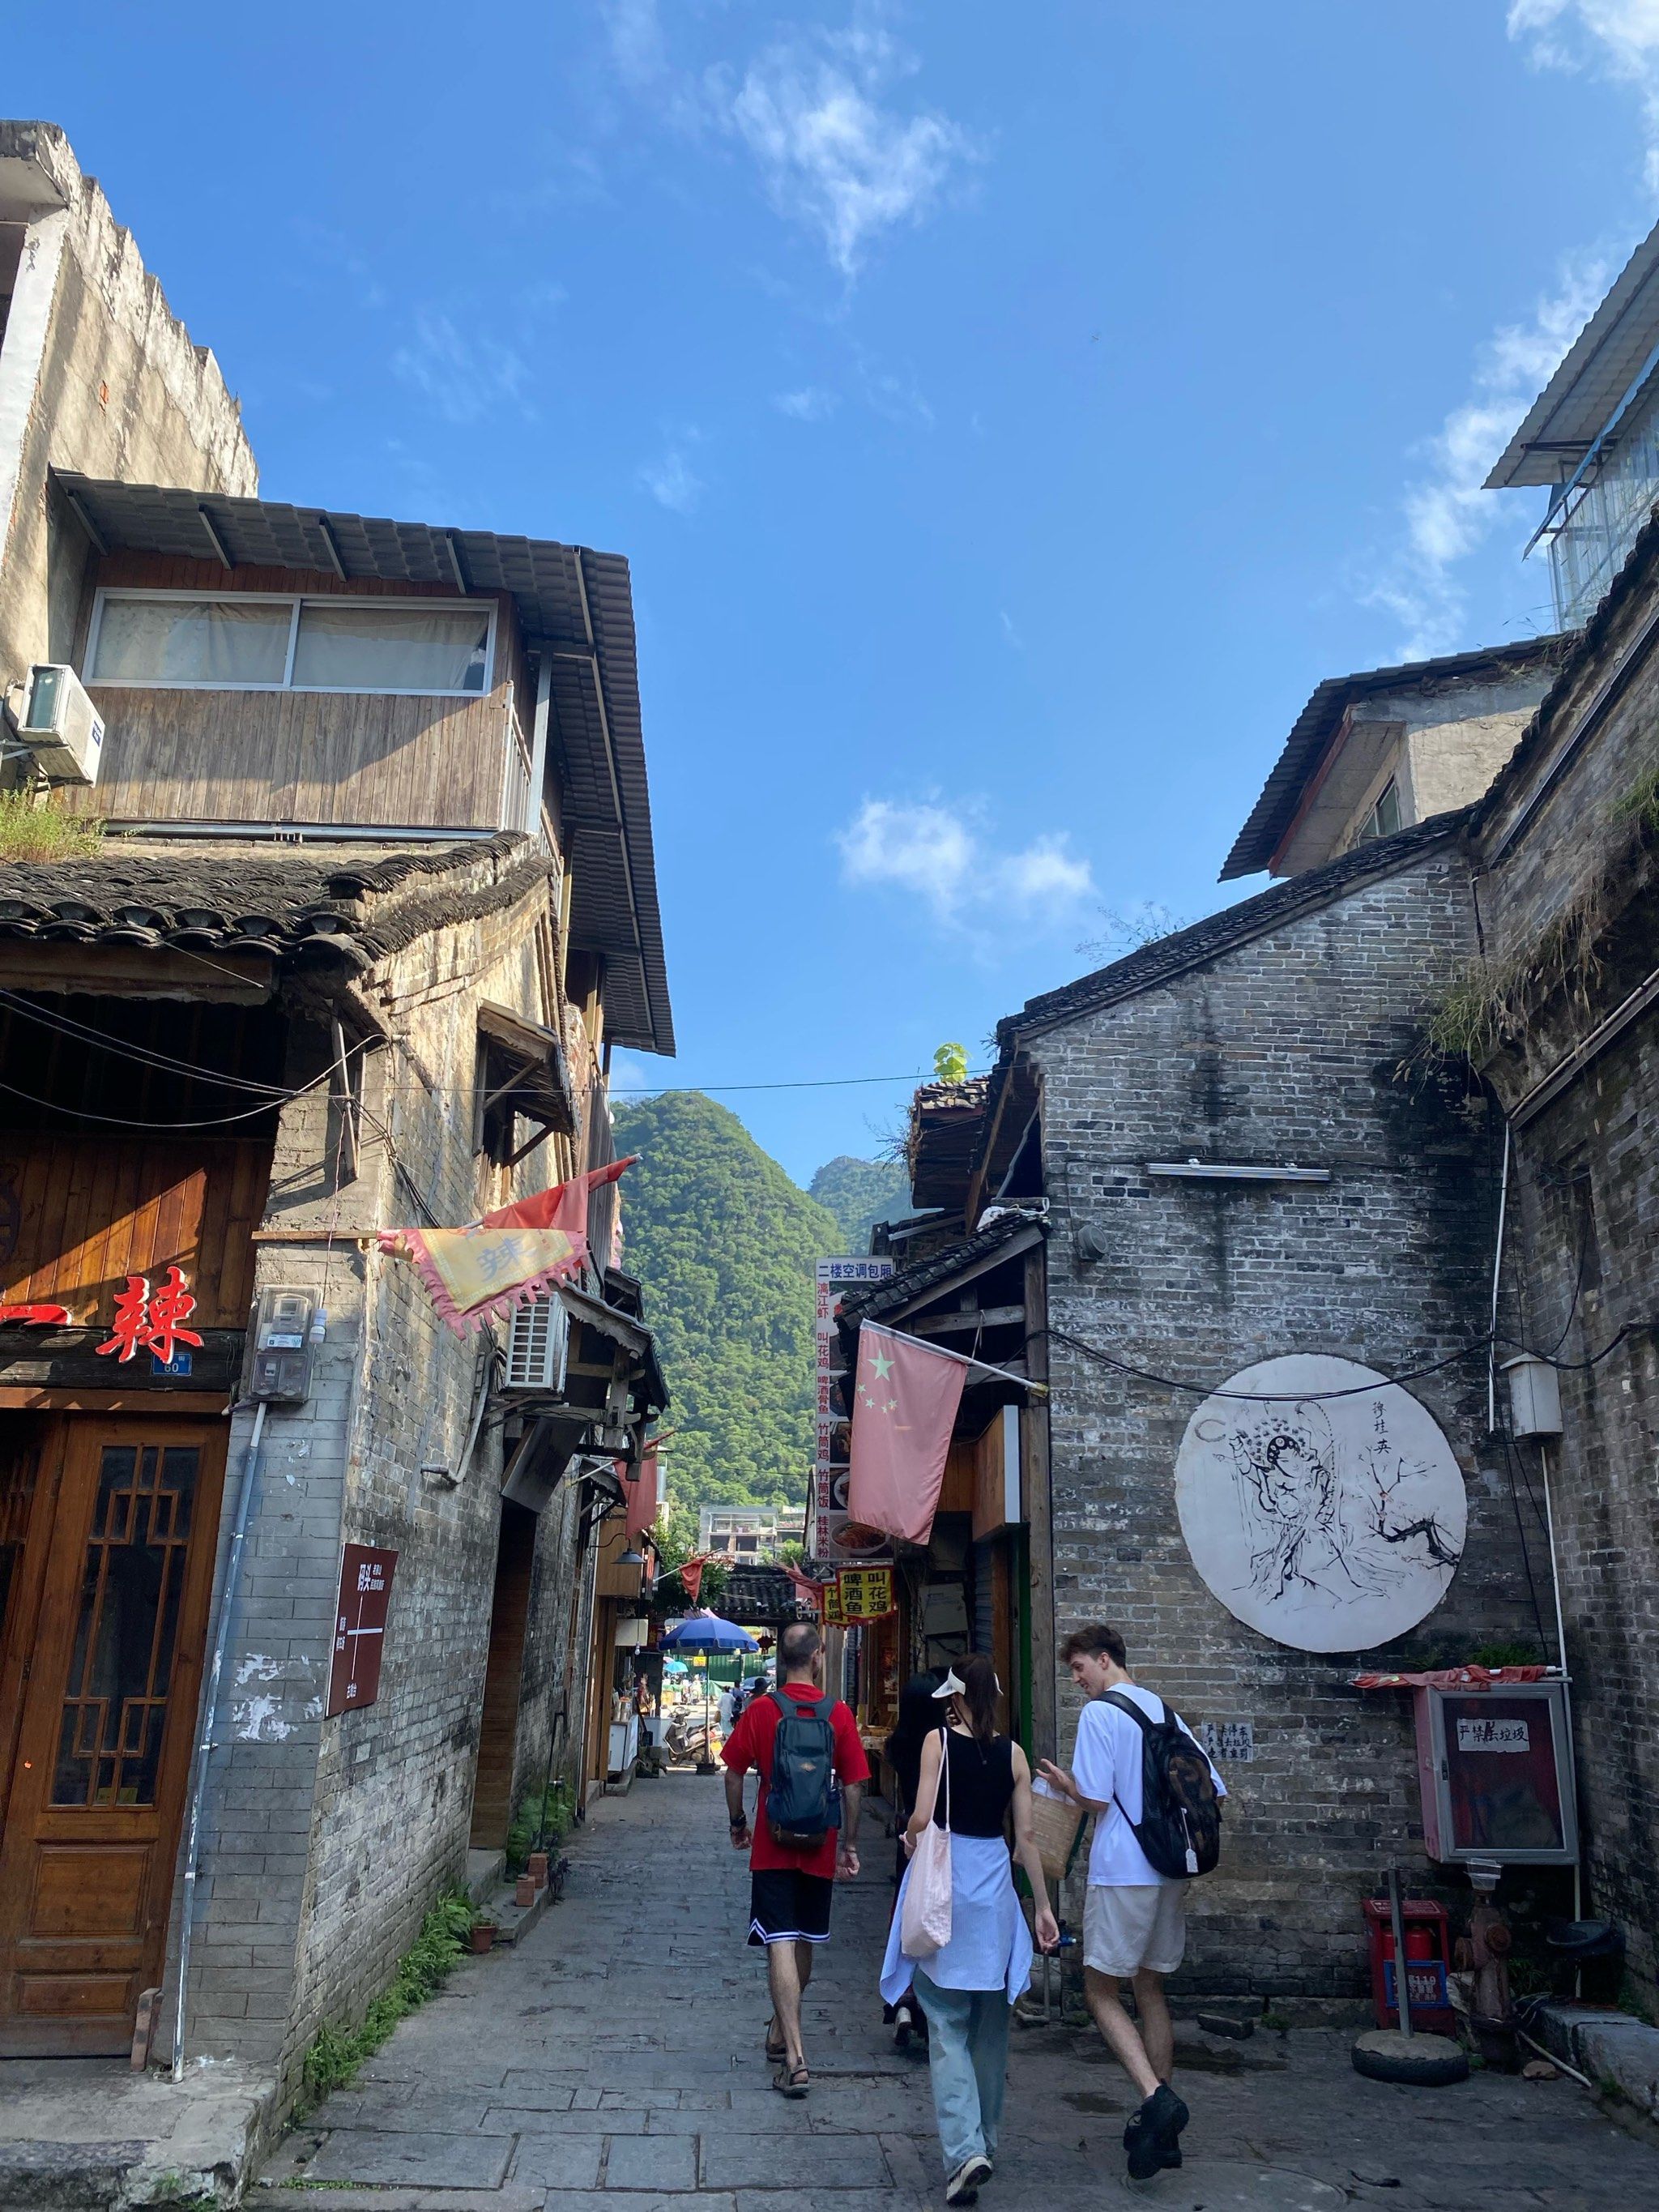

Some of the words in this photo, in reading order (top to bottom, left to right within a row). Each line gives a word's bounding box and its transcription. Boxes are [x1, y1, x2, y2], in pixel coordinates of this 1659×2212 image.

[819, 1263, 891, 1279] 二楼空调包厢
[817, 1283, 830, 1318] 漓江虾
[164, 1363, 179, 1373] 60
[817, 1332, 829, 1369] 叫花鸡
[817, 1423, 830, 1461] 竹筒鸡
[817, 1469, 830, 1508] 竹筒饭
[817, 1515, 830, 1558] 桂林米粉
[843, 1574, 864, 1614] 啤酒鱼
[868, 1572, 887, 1612] 叫花鸡
